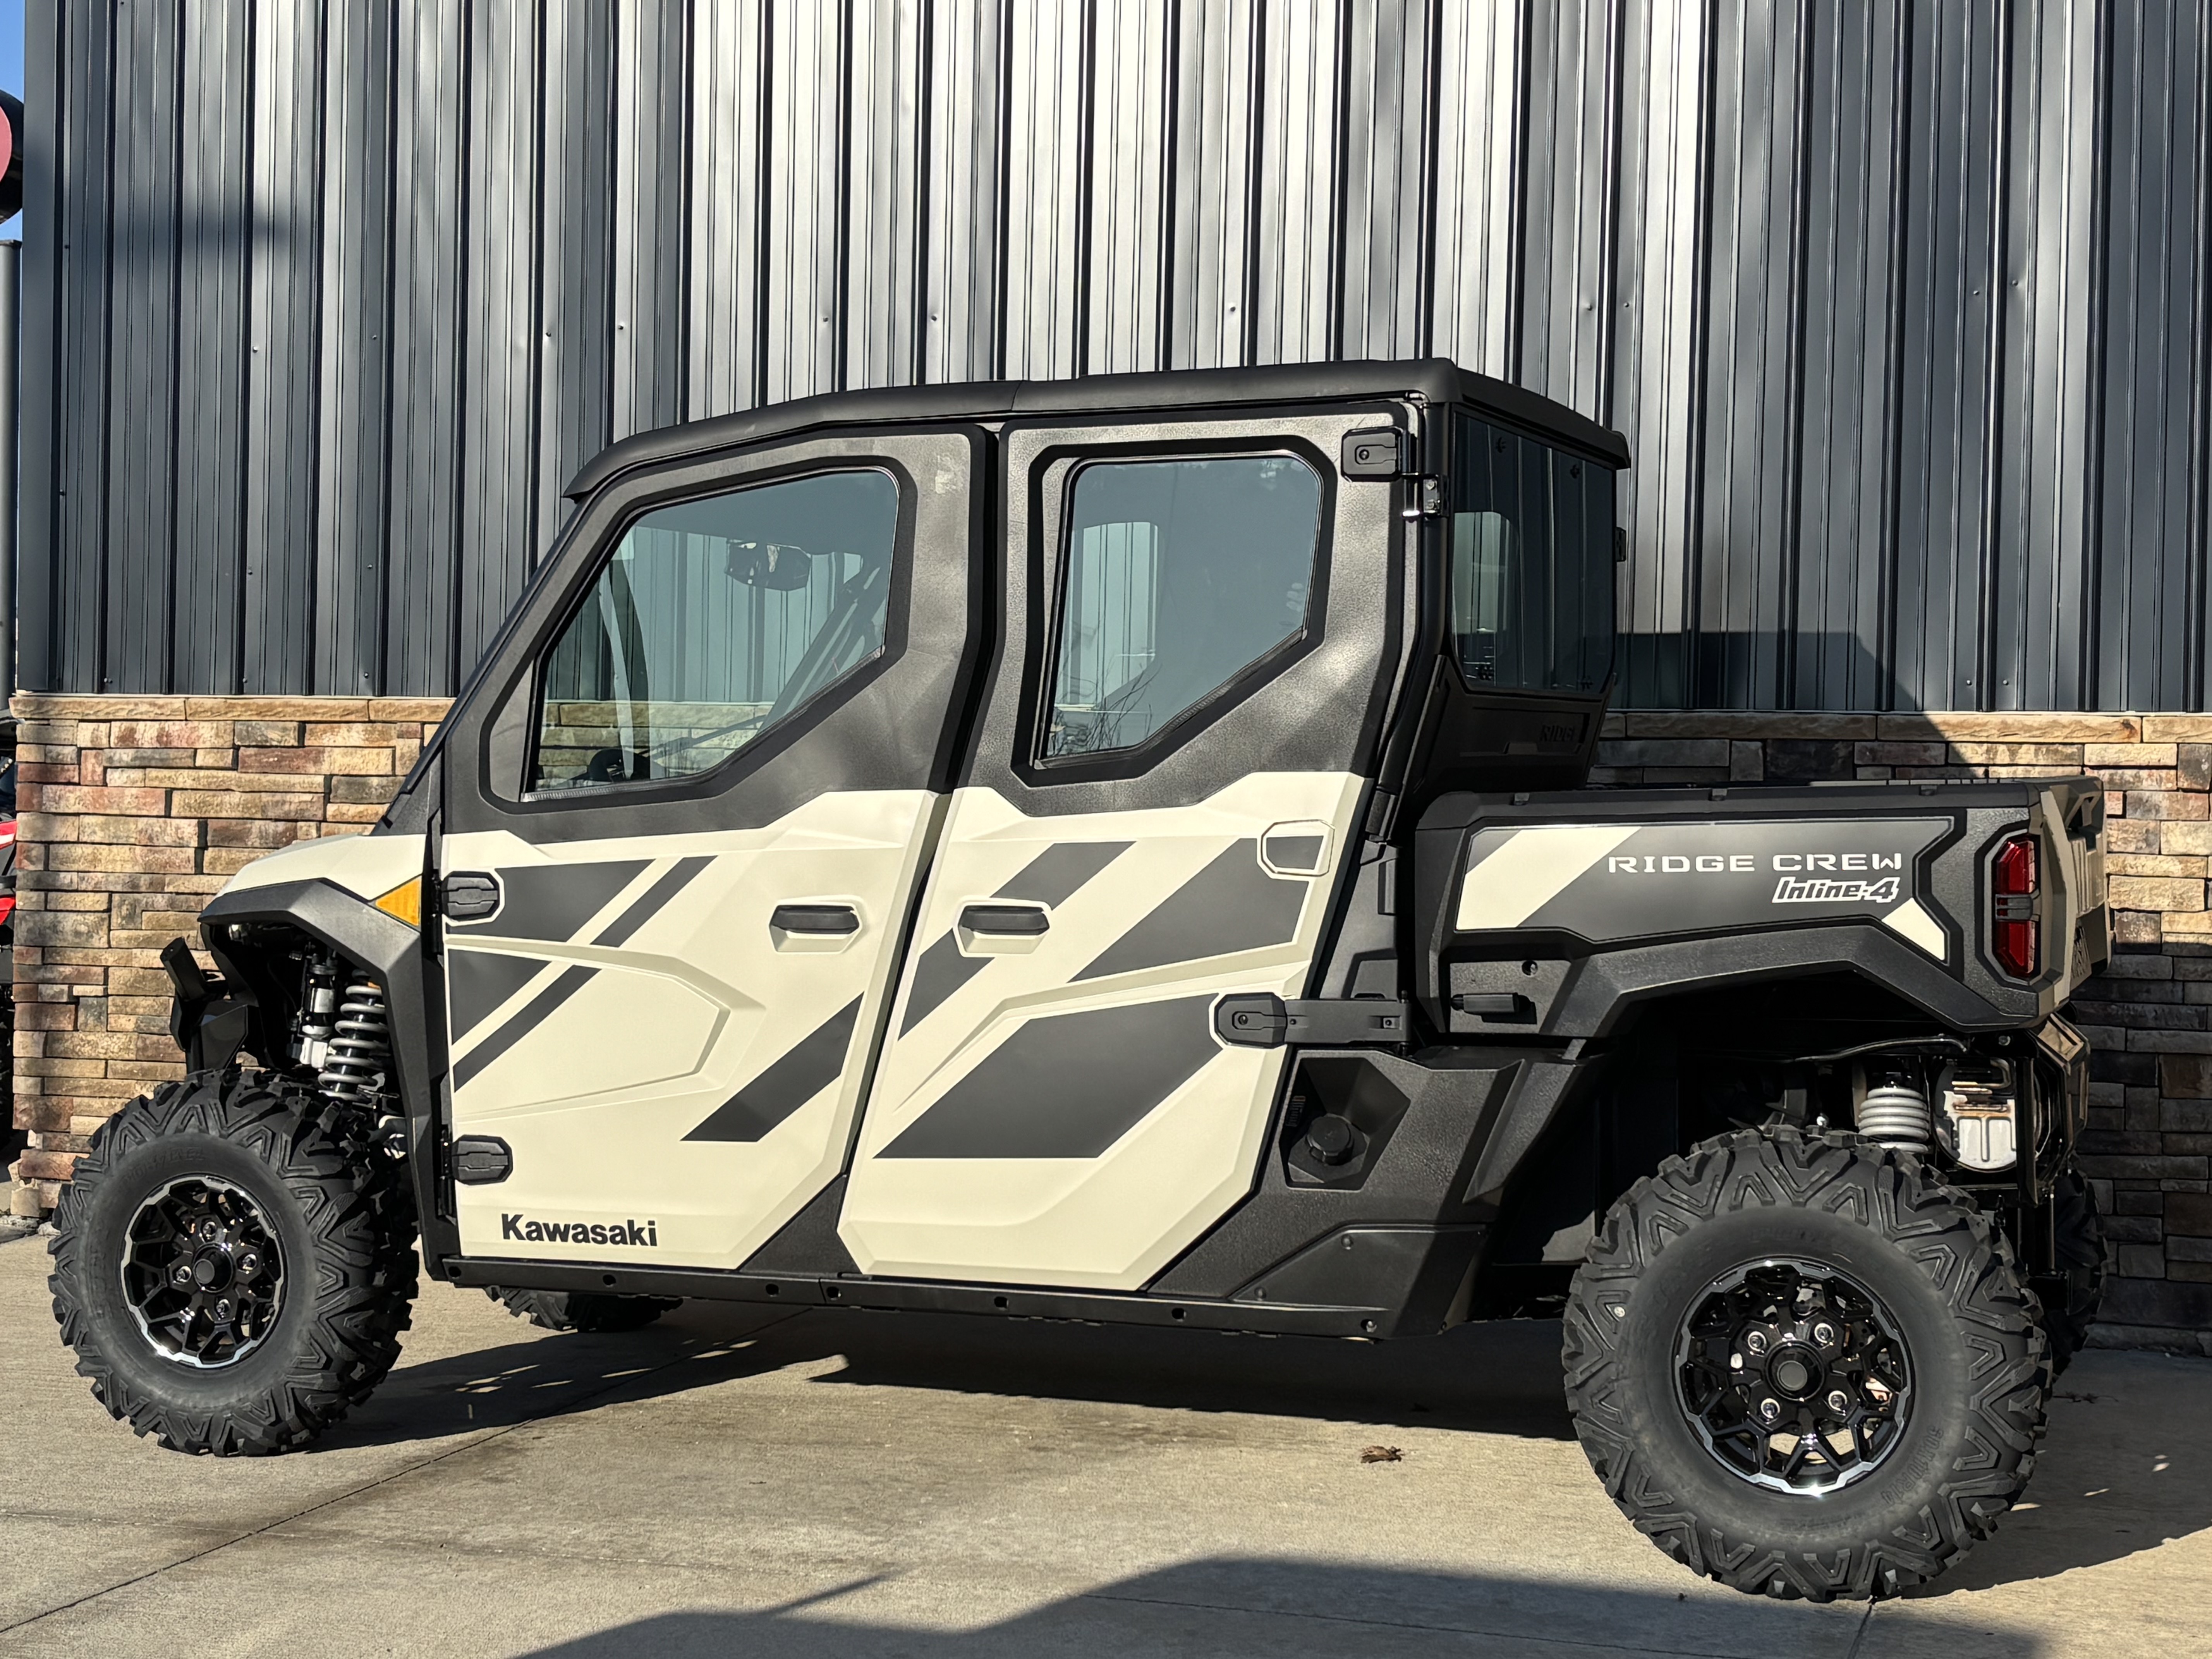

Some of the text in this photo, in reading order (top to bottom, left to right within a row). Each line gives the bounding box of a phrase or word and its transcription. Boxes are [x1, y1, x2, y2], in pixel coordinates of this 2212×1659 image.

[1608, 853, 1902, 873] RIDGE CREW
[1772, 876, 1900, 903] Inline-4
[501, 1213, 658, 1247] Kawasaki
